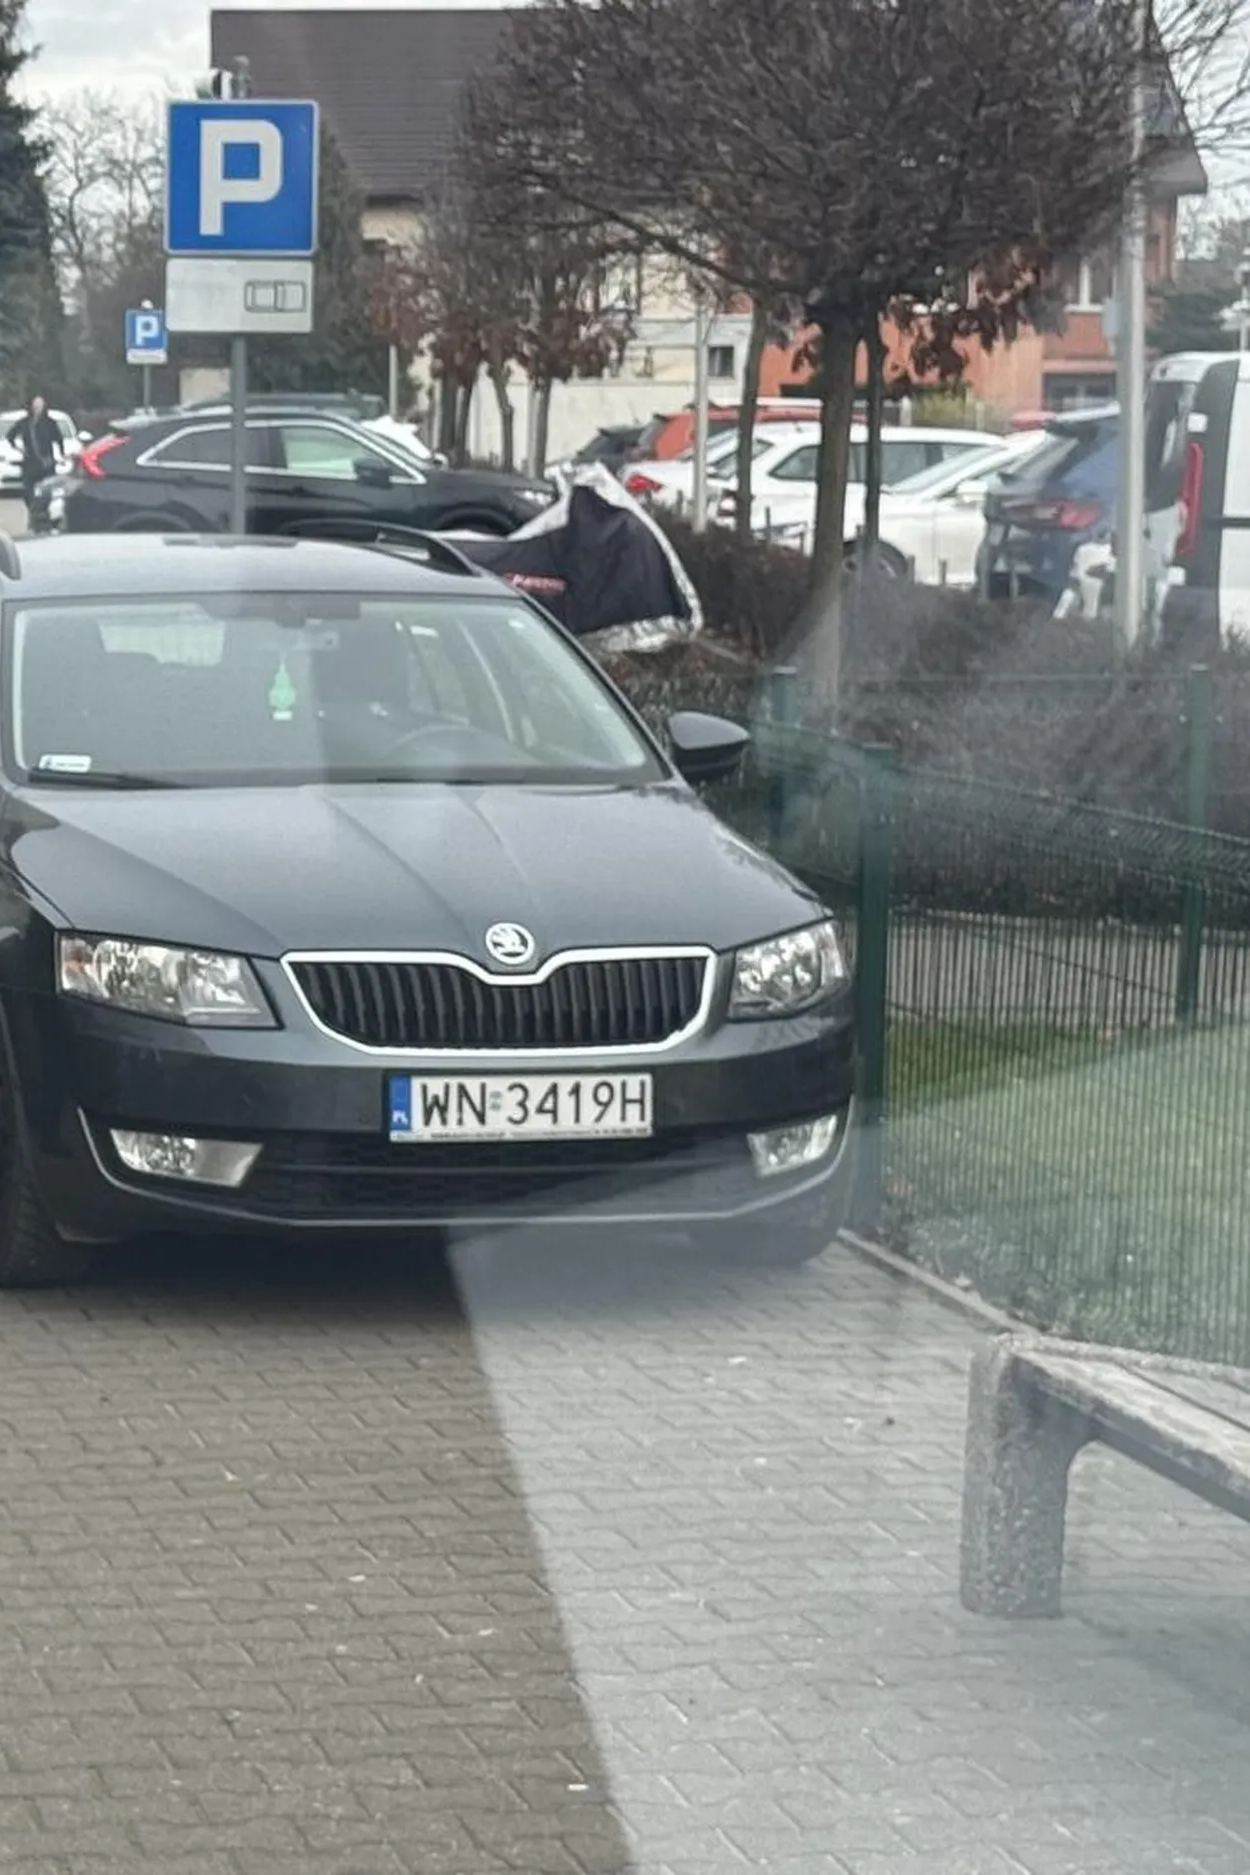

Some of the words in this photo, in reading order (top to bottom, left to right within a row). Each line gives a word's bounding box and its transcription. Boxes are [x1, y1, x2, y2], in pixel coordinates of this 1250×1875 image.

[199, 119, 283, 236] P
[135, 315, 159, 346] P
[420, 1081, 487, 1127] WN
[506, 1079, 646, 1125] 3419H
